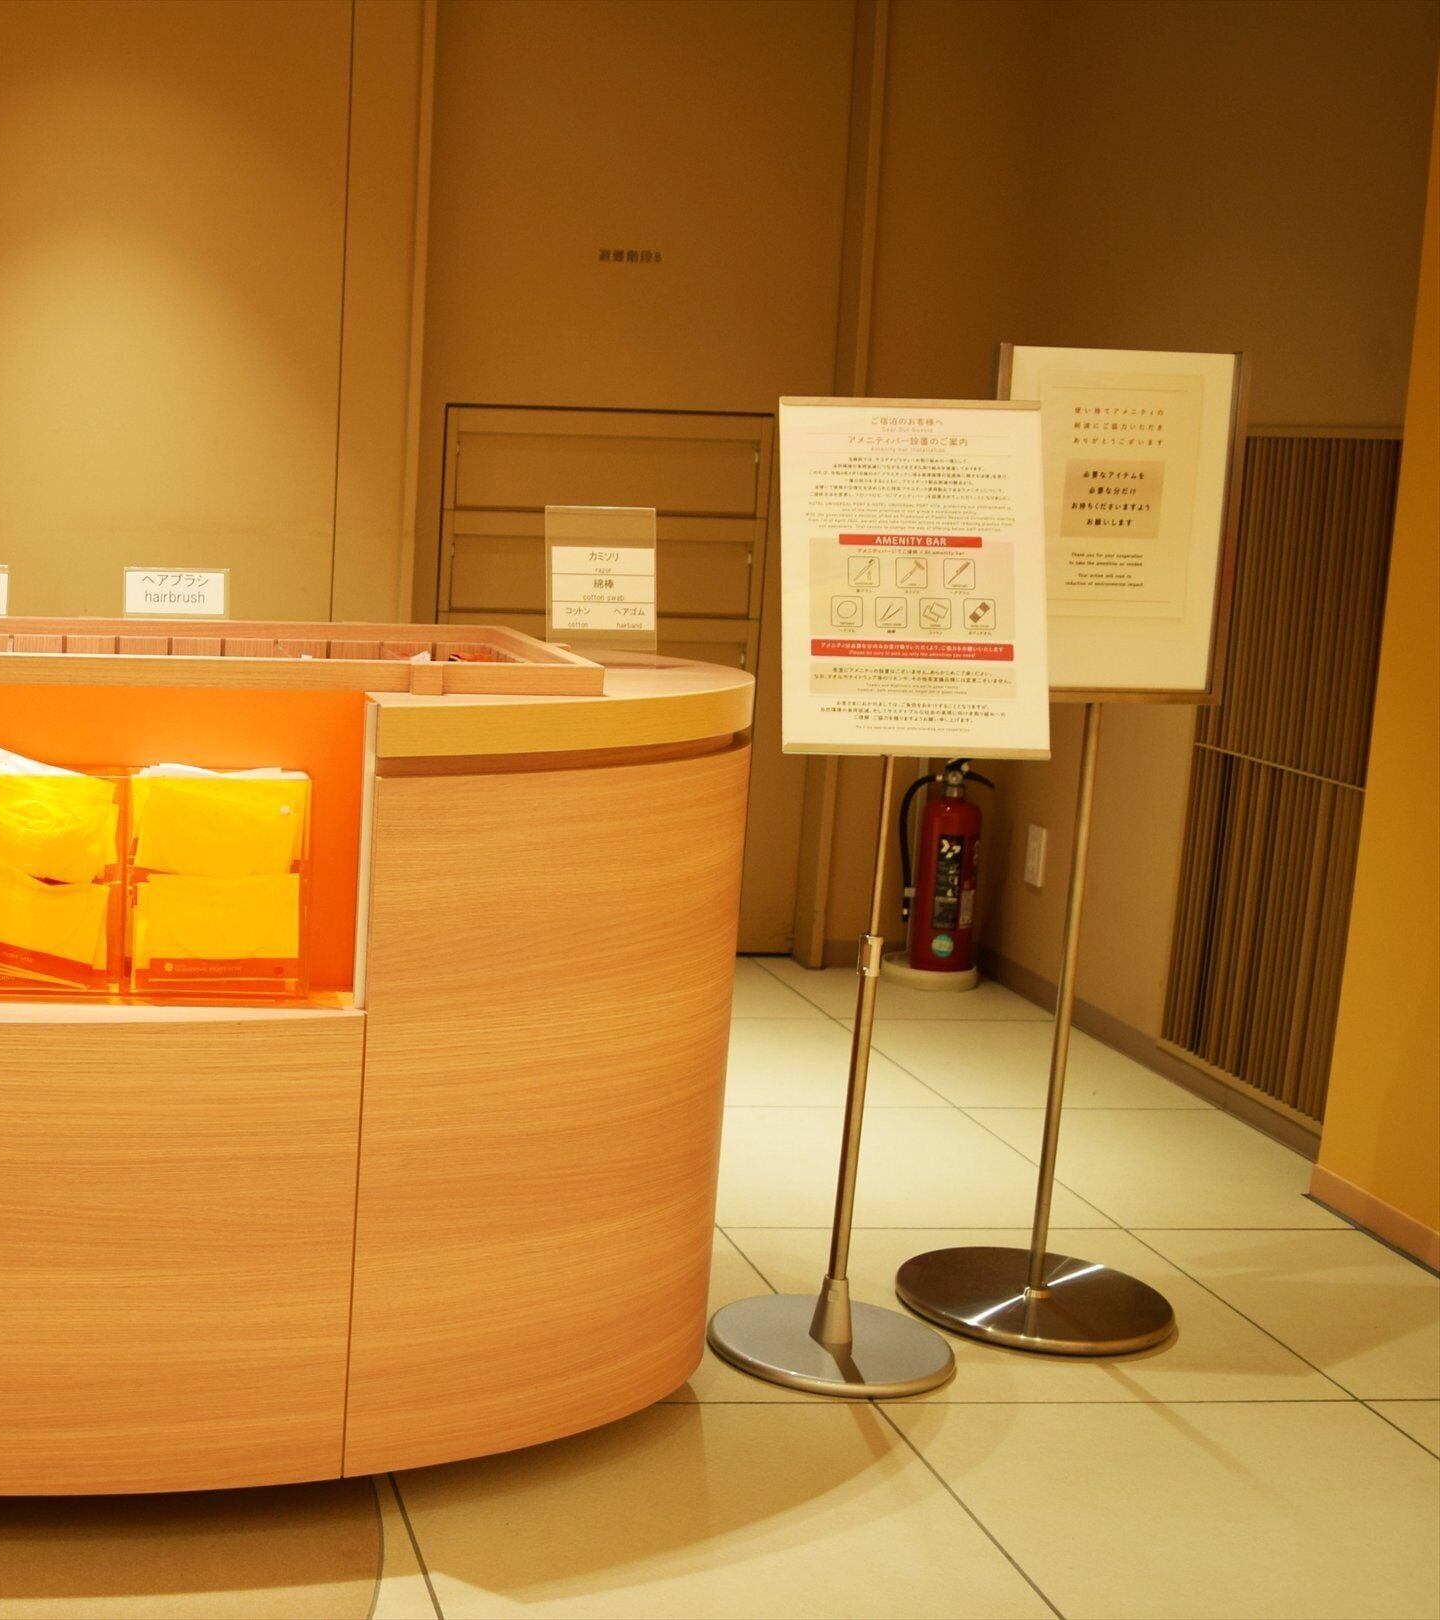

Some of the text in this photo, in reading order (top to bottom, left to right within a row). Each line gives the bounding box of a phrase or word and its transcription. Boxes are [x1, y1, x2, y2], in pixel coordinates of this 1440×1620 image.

[875, 536, 947, 546] AMENITY BAR
[589, 551, 619, 562] カミソリ
[142, 573, 209, 588] ヘアブラシ
[593, 579, 614, 589] 綿棒
[144, 589, 206, 605] hairbrush
[565, 607, 645, 616] コットン ヘアゴム
